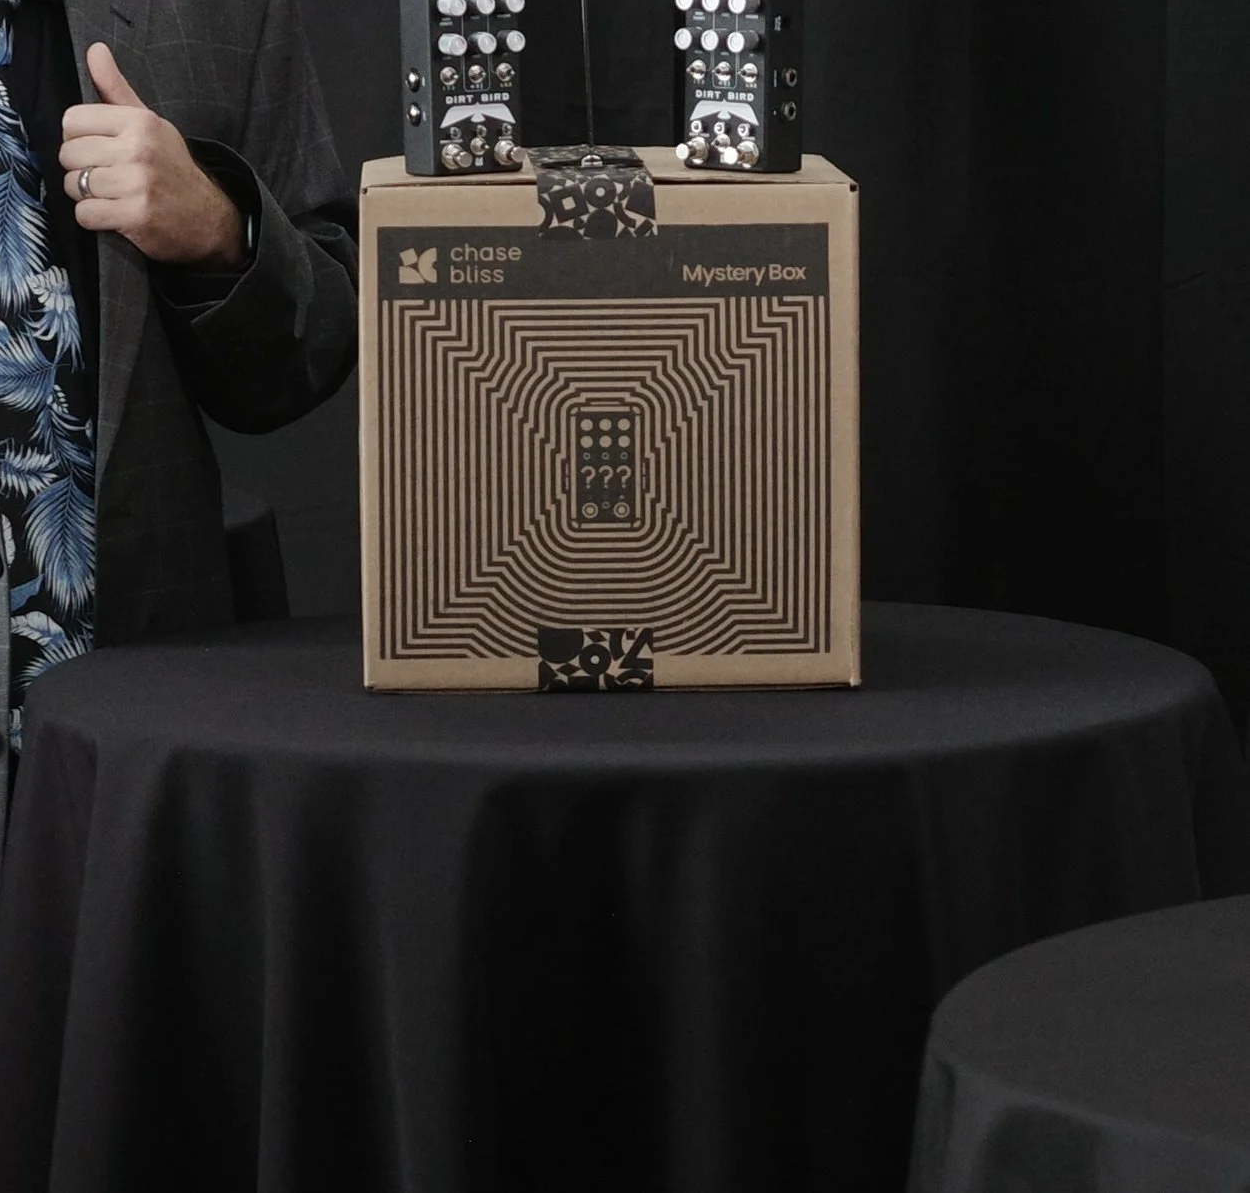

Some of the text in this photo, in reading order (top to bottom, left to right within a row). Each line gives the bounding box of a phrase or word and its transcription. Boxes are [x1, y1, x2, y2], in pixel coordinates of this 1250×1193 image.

[445, 92, 510, 105] DIRT BIRD
[695, 89, 755, 102] DIRT BIRD
[449, 242, 523, 262] chase
[449, 264, 505, 284] bliss
[681, 263, 807, 288] Mystery Box
